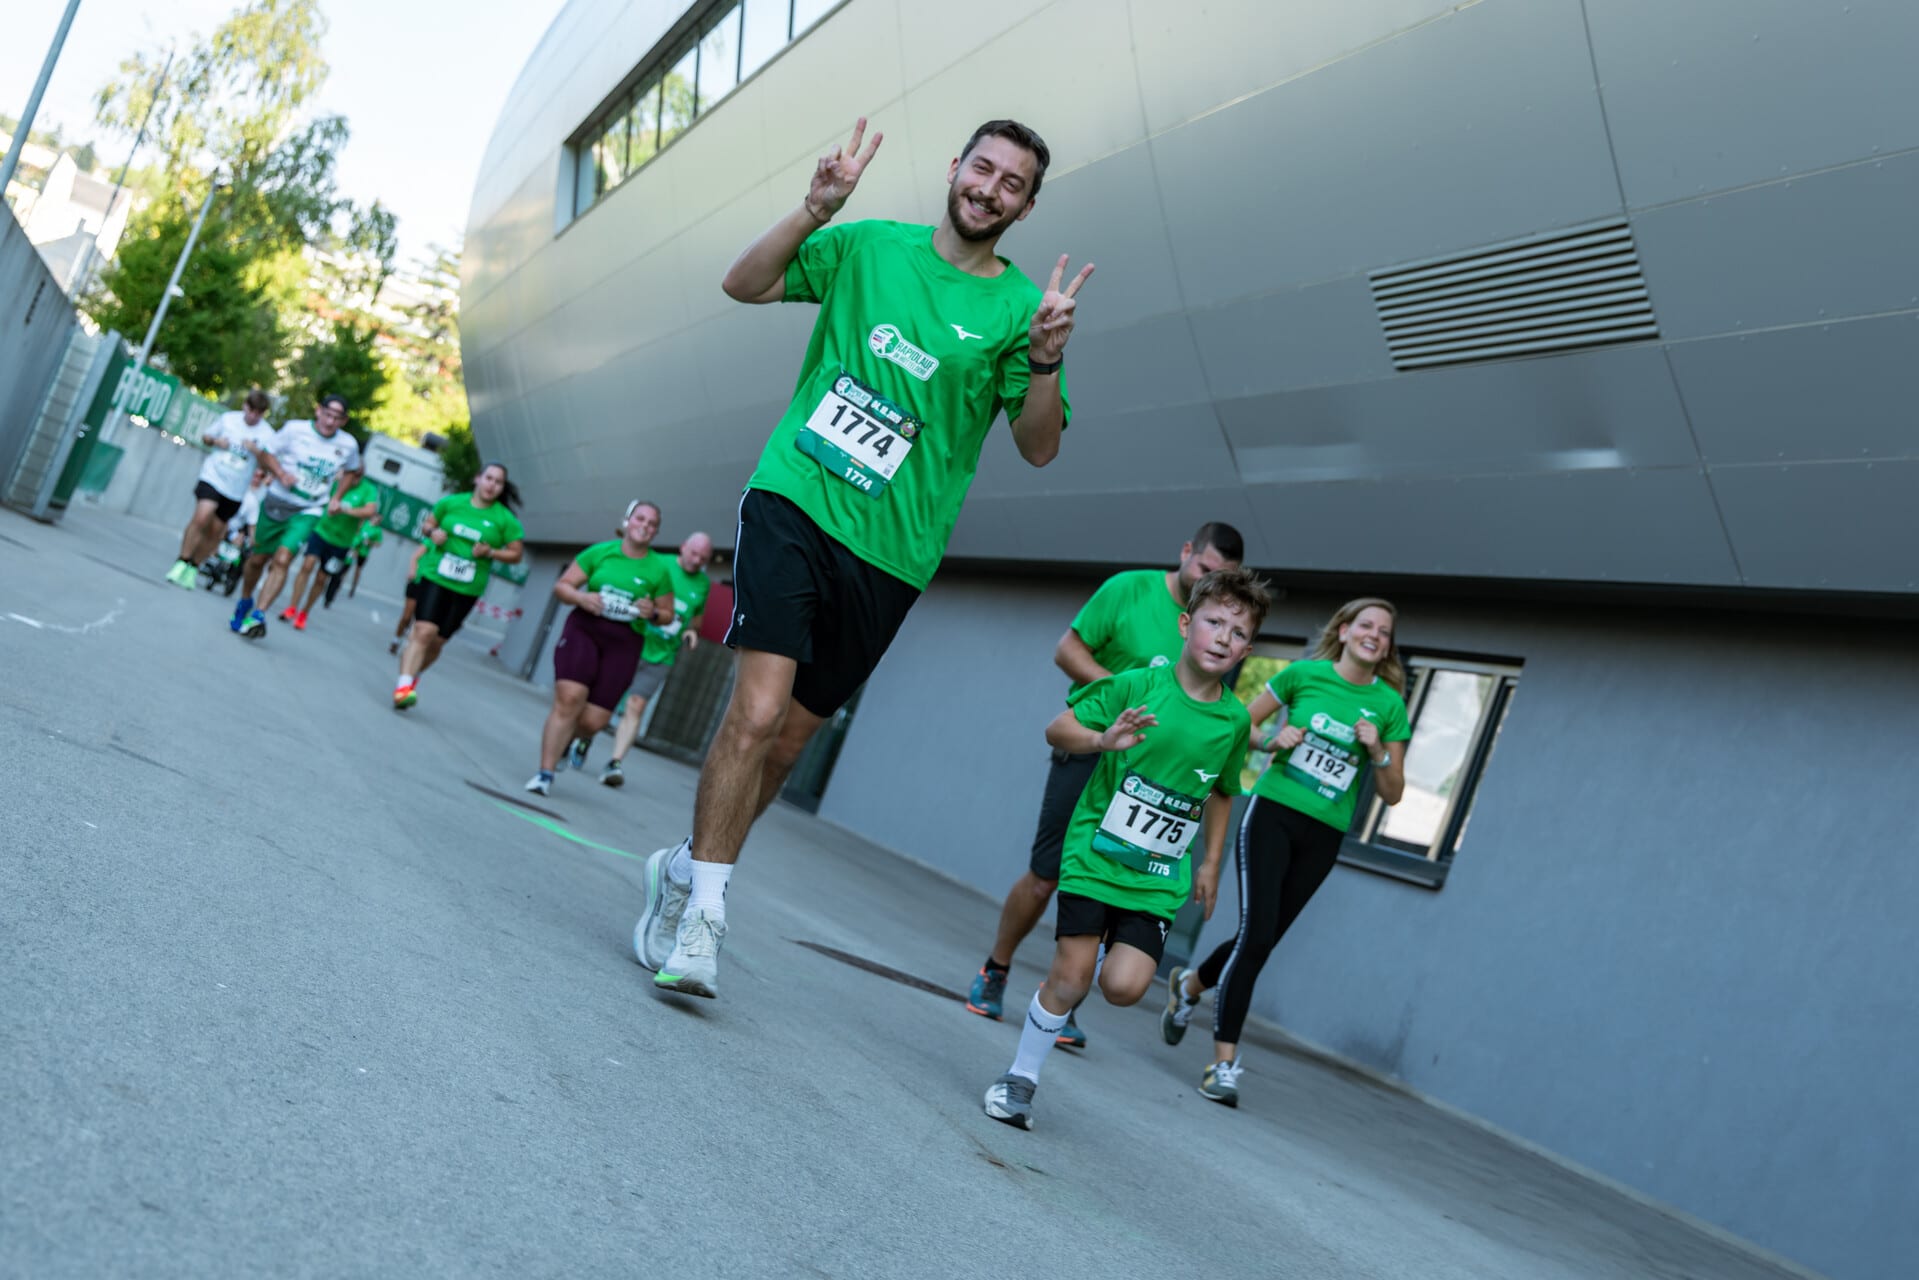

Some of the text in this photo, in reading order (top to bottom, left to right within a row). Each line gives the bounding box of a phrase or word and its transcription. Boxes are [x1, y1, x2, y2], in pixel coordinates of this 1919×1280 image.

[895, 342, 936, 371] RAPIDLAUF
[830, 404, 895, 458] 1774
[845, 467, 873, 491] 1774
[1304, 749, 1346, 779] 1192
[1125, 804, 1186, 844] 1775
[1147, 860, 1170, 876] 1775
